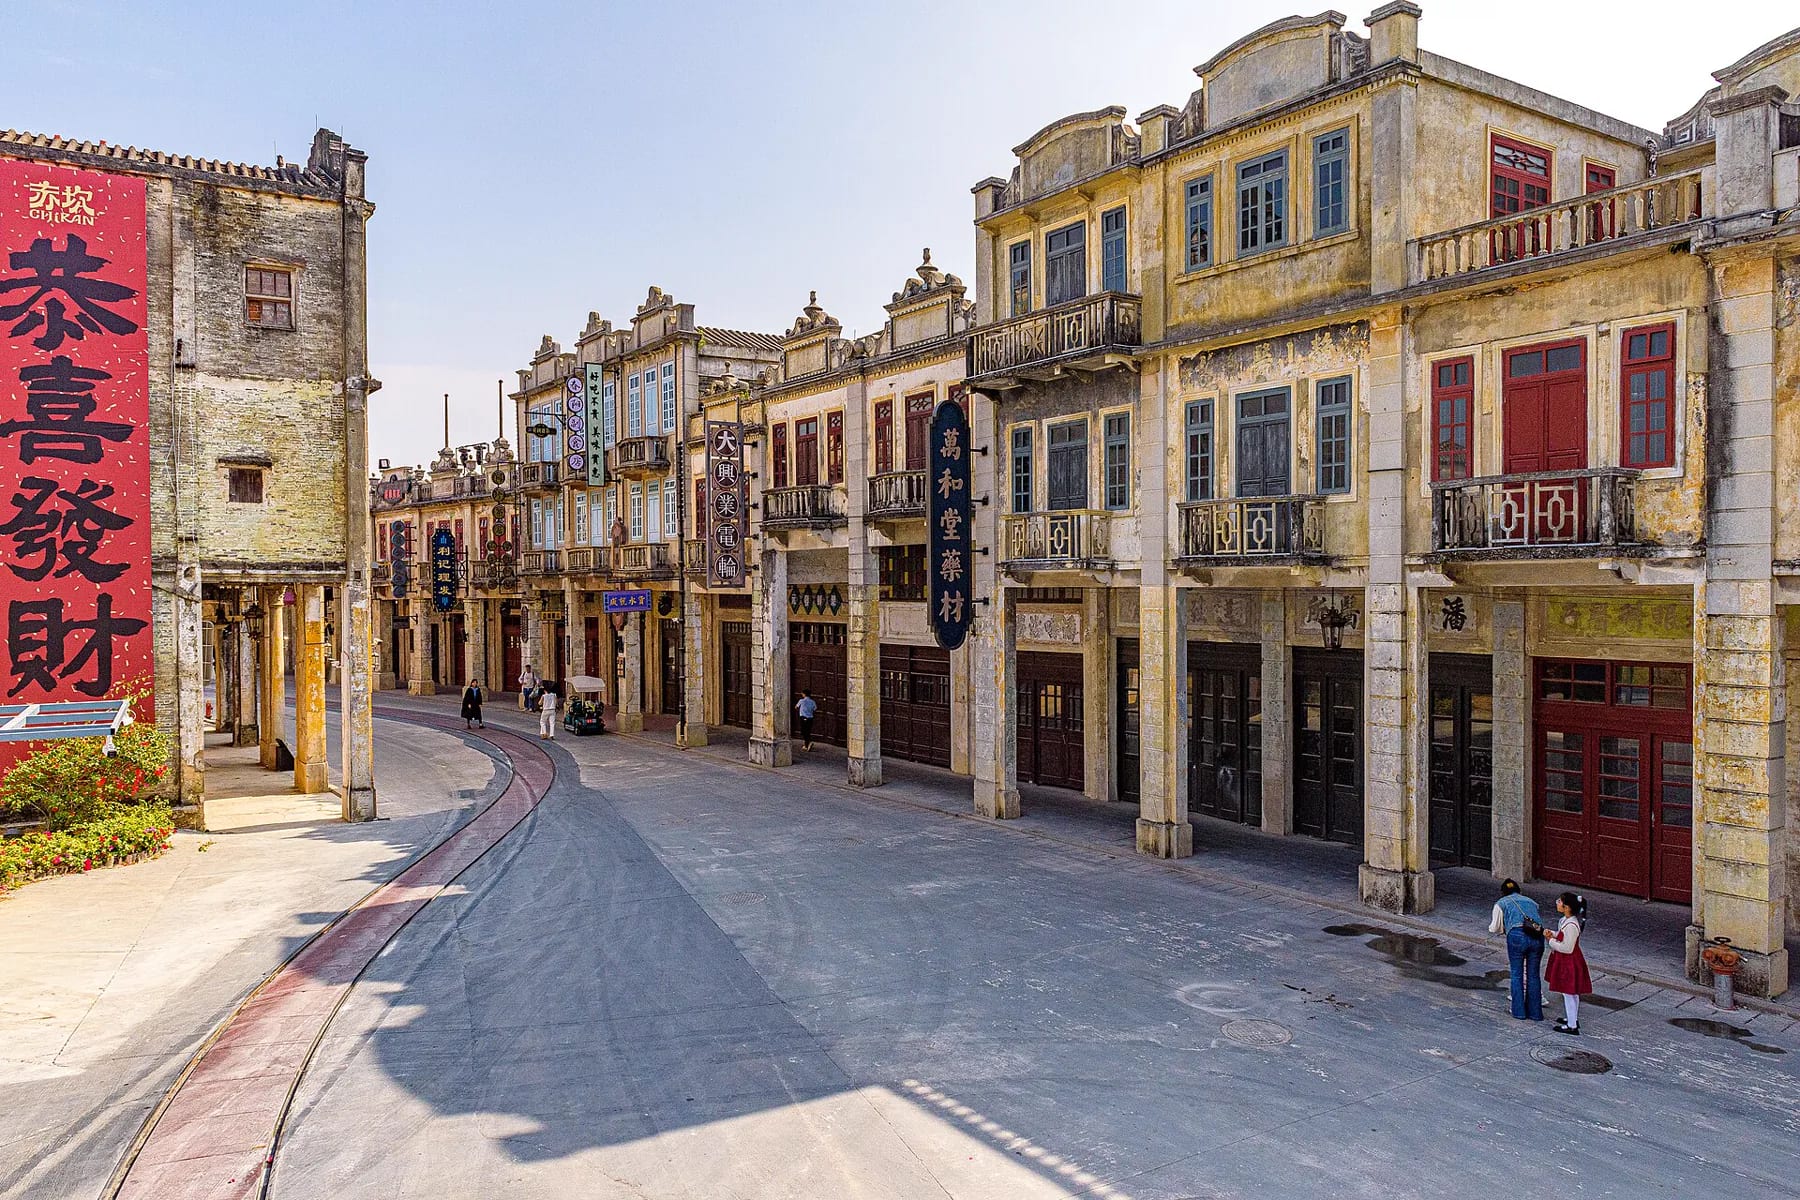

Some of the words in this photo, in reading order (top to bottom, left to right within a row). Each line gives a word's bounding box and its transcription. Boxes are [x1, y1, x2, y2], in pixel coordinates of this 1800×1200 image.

[29, 180, 95, 216] 赤坎
[0, 233, 149, 698] 恭喜發財
[716, 430, 737, 578] 大興業電輪
[937, 427, 965, 623] 萬和堂藥材
[1441, 595, 1468, 633] 潘
